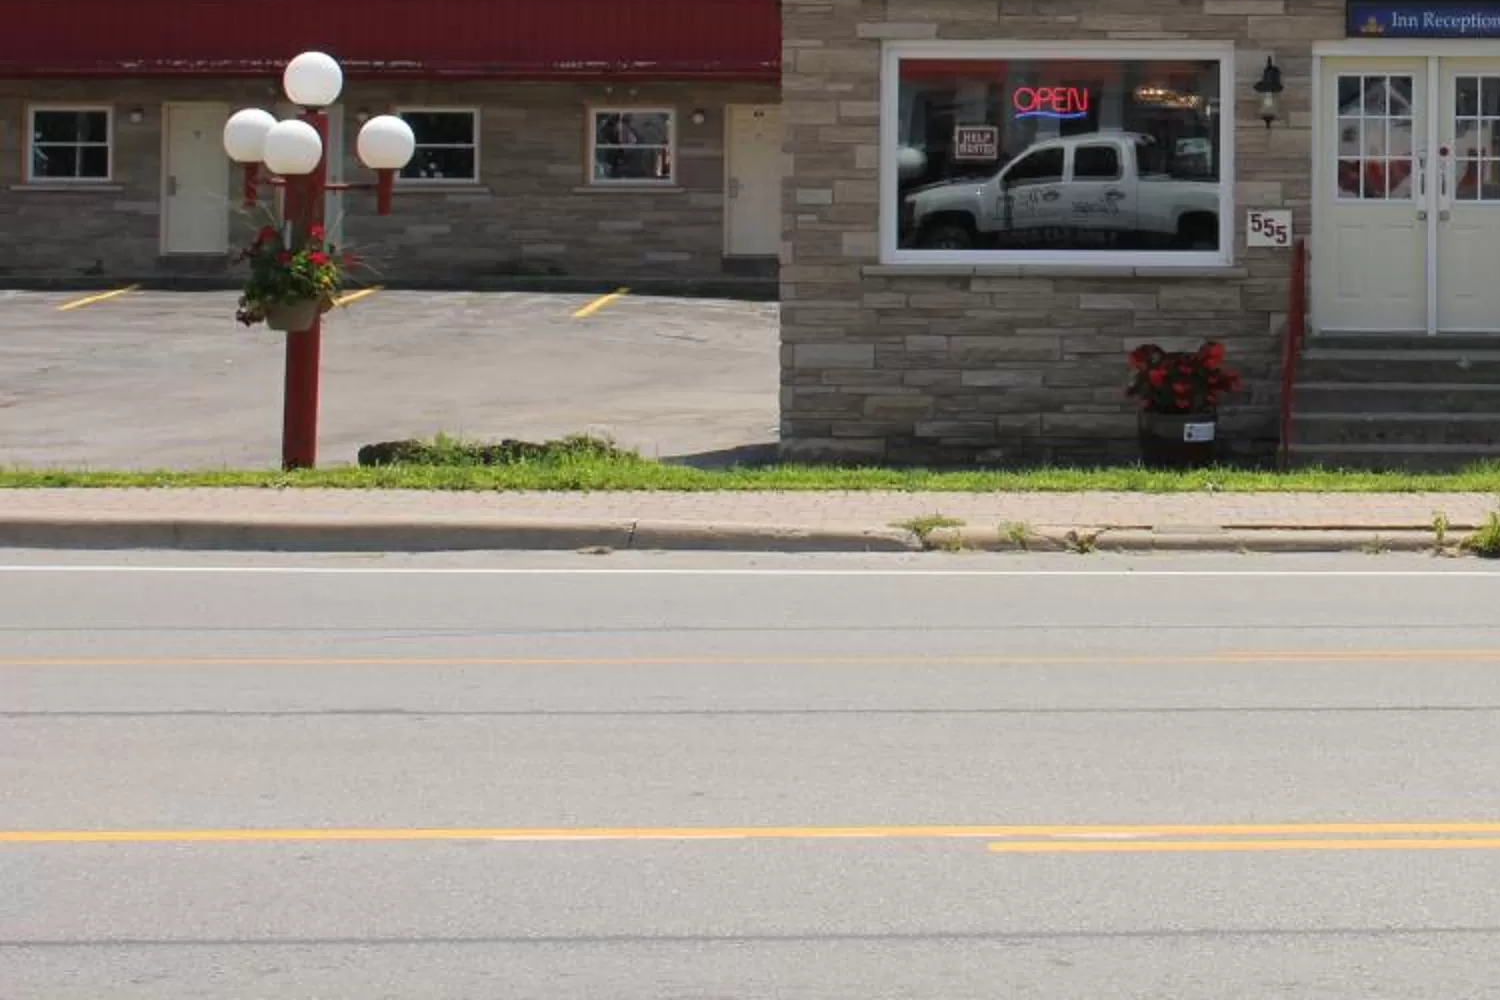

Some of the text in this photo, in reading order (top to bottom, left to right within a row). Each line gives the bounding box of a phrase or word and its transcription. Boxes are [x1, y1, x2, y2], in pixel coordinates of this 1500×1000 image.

[1391, 11, 1419, 28] Inn
[1013, 87, 1089, 112] OPEN
[1251, 213, 1287, 245] 555
